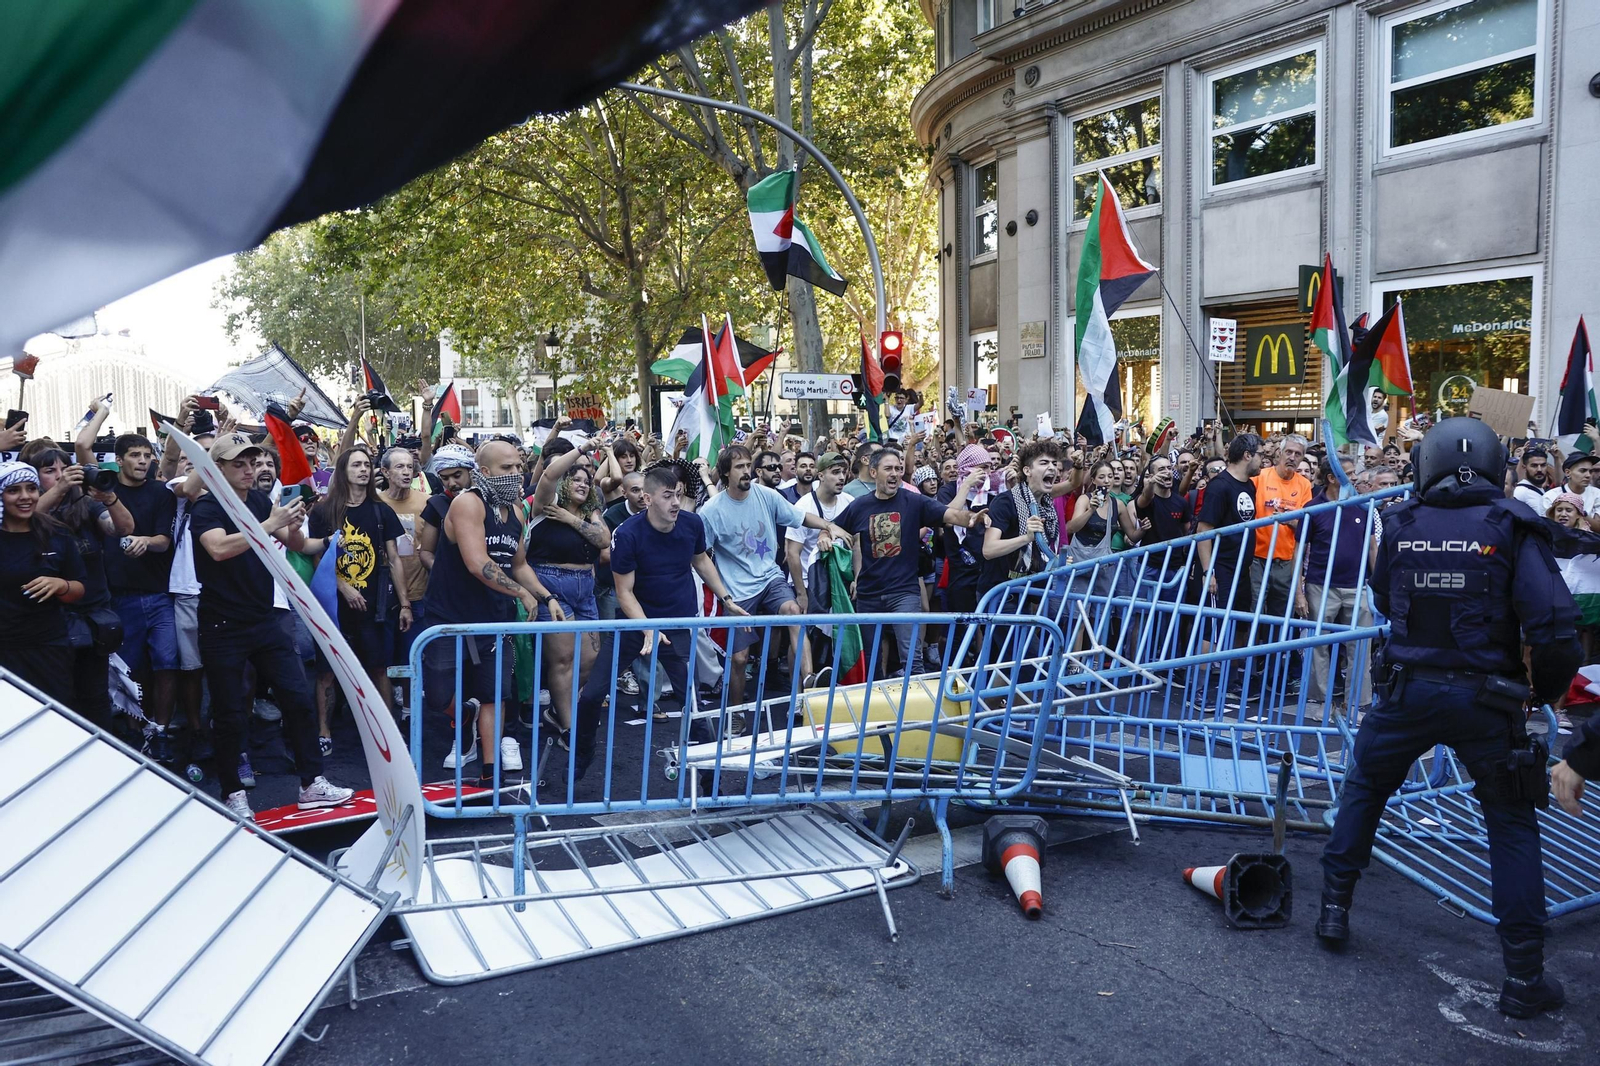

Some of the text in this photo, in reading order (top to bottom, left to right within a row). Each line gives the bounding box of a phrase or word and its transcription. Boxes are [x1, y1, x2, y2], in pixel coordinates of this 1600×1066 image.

[1452, 319, 1532, 333] McDonald's
[1117, 348, 1160, 358] McDonald'
[1398, 540, 1482, 552] POLICIA
[1414, 572, 1466, 588] UC23
